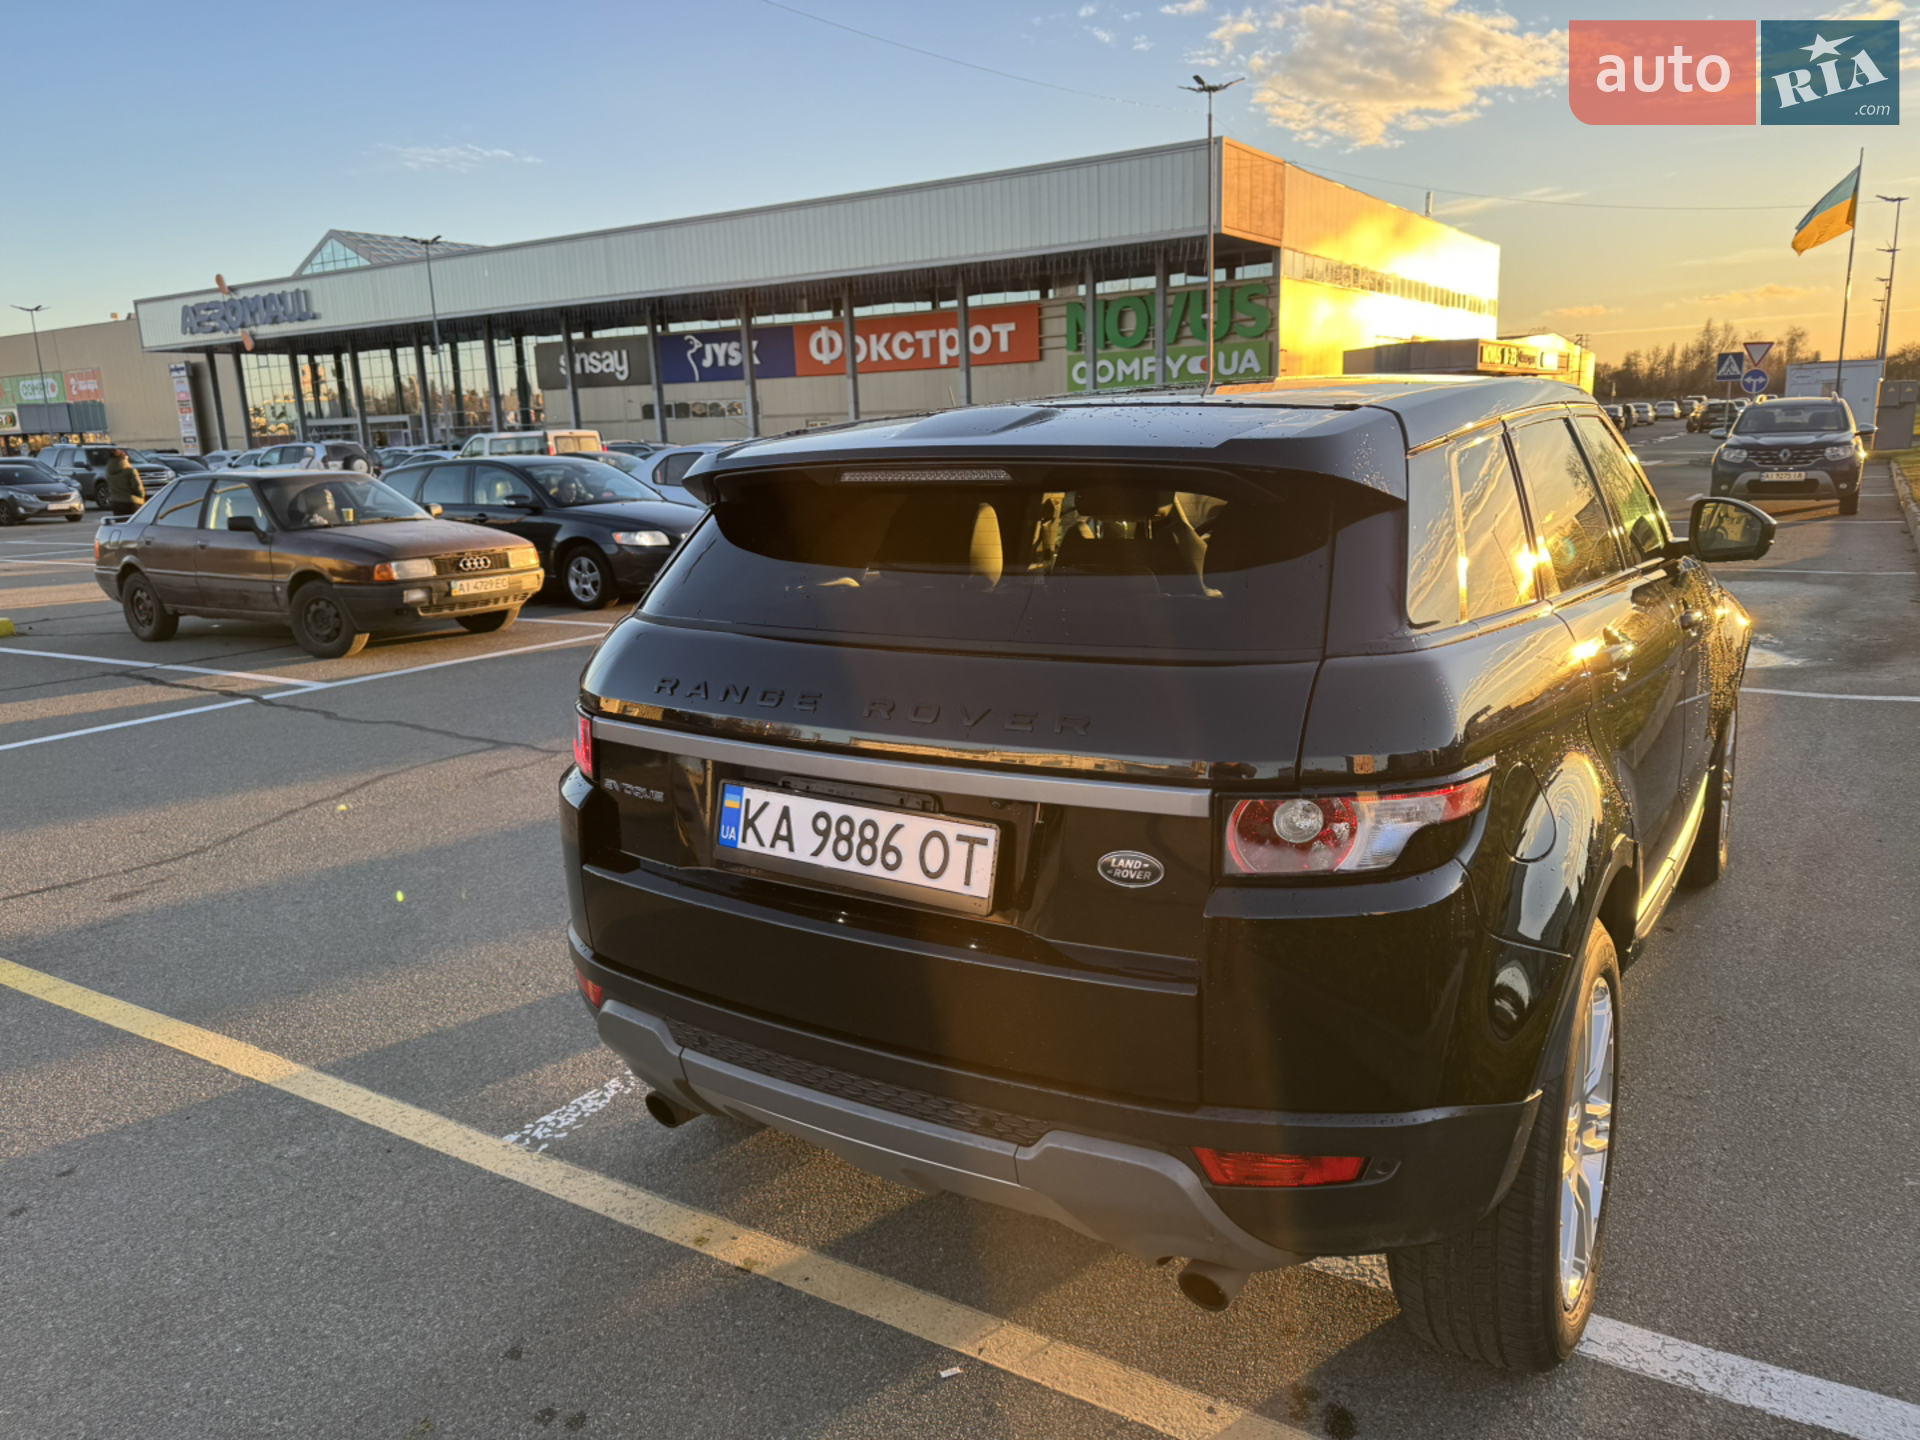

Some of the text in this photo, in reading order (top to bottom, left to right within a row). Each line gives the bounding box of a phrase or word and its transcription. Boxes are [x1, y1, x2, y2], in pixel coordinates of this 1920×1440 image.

[1066, 284, 1270, 352] NOVUS
[559, 346, 629, 381] snsay
[1072, 348, 1261, 385] COMFY UA
[653, 675, 1093, 737] RANGE ROVER
[721, 798, 988, 886] UA KA 9886 OT
[1111, 858, 1142, 869] LAND
[1113, 868, 1152, 880] ROVER
